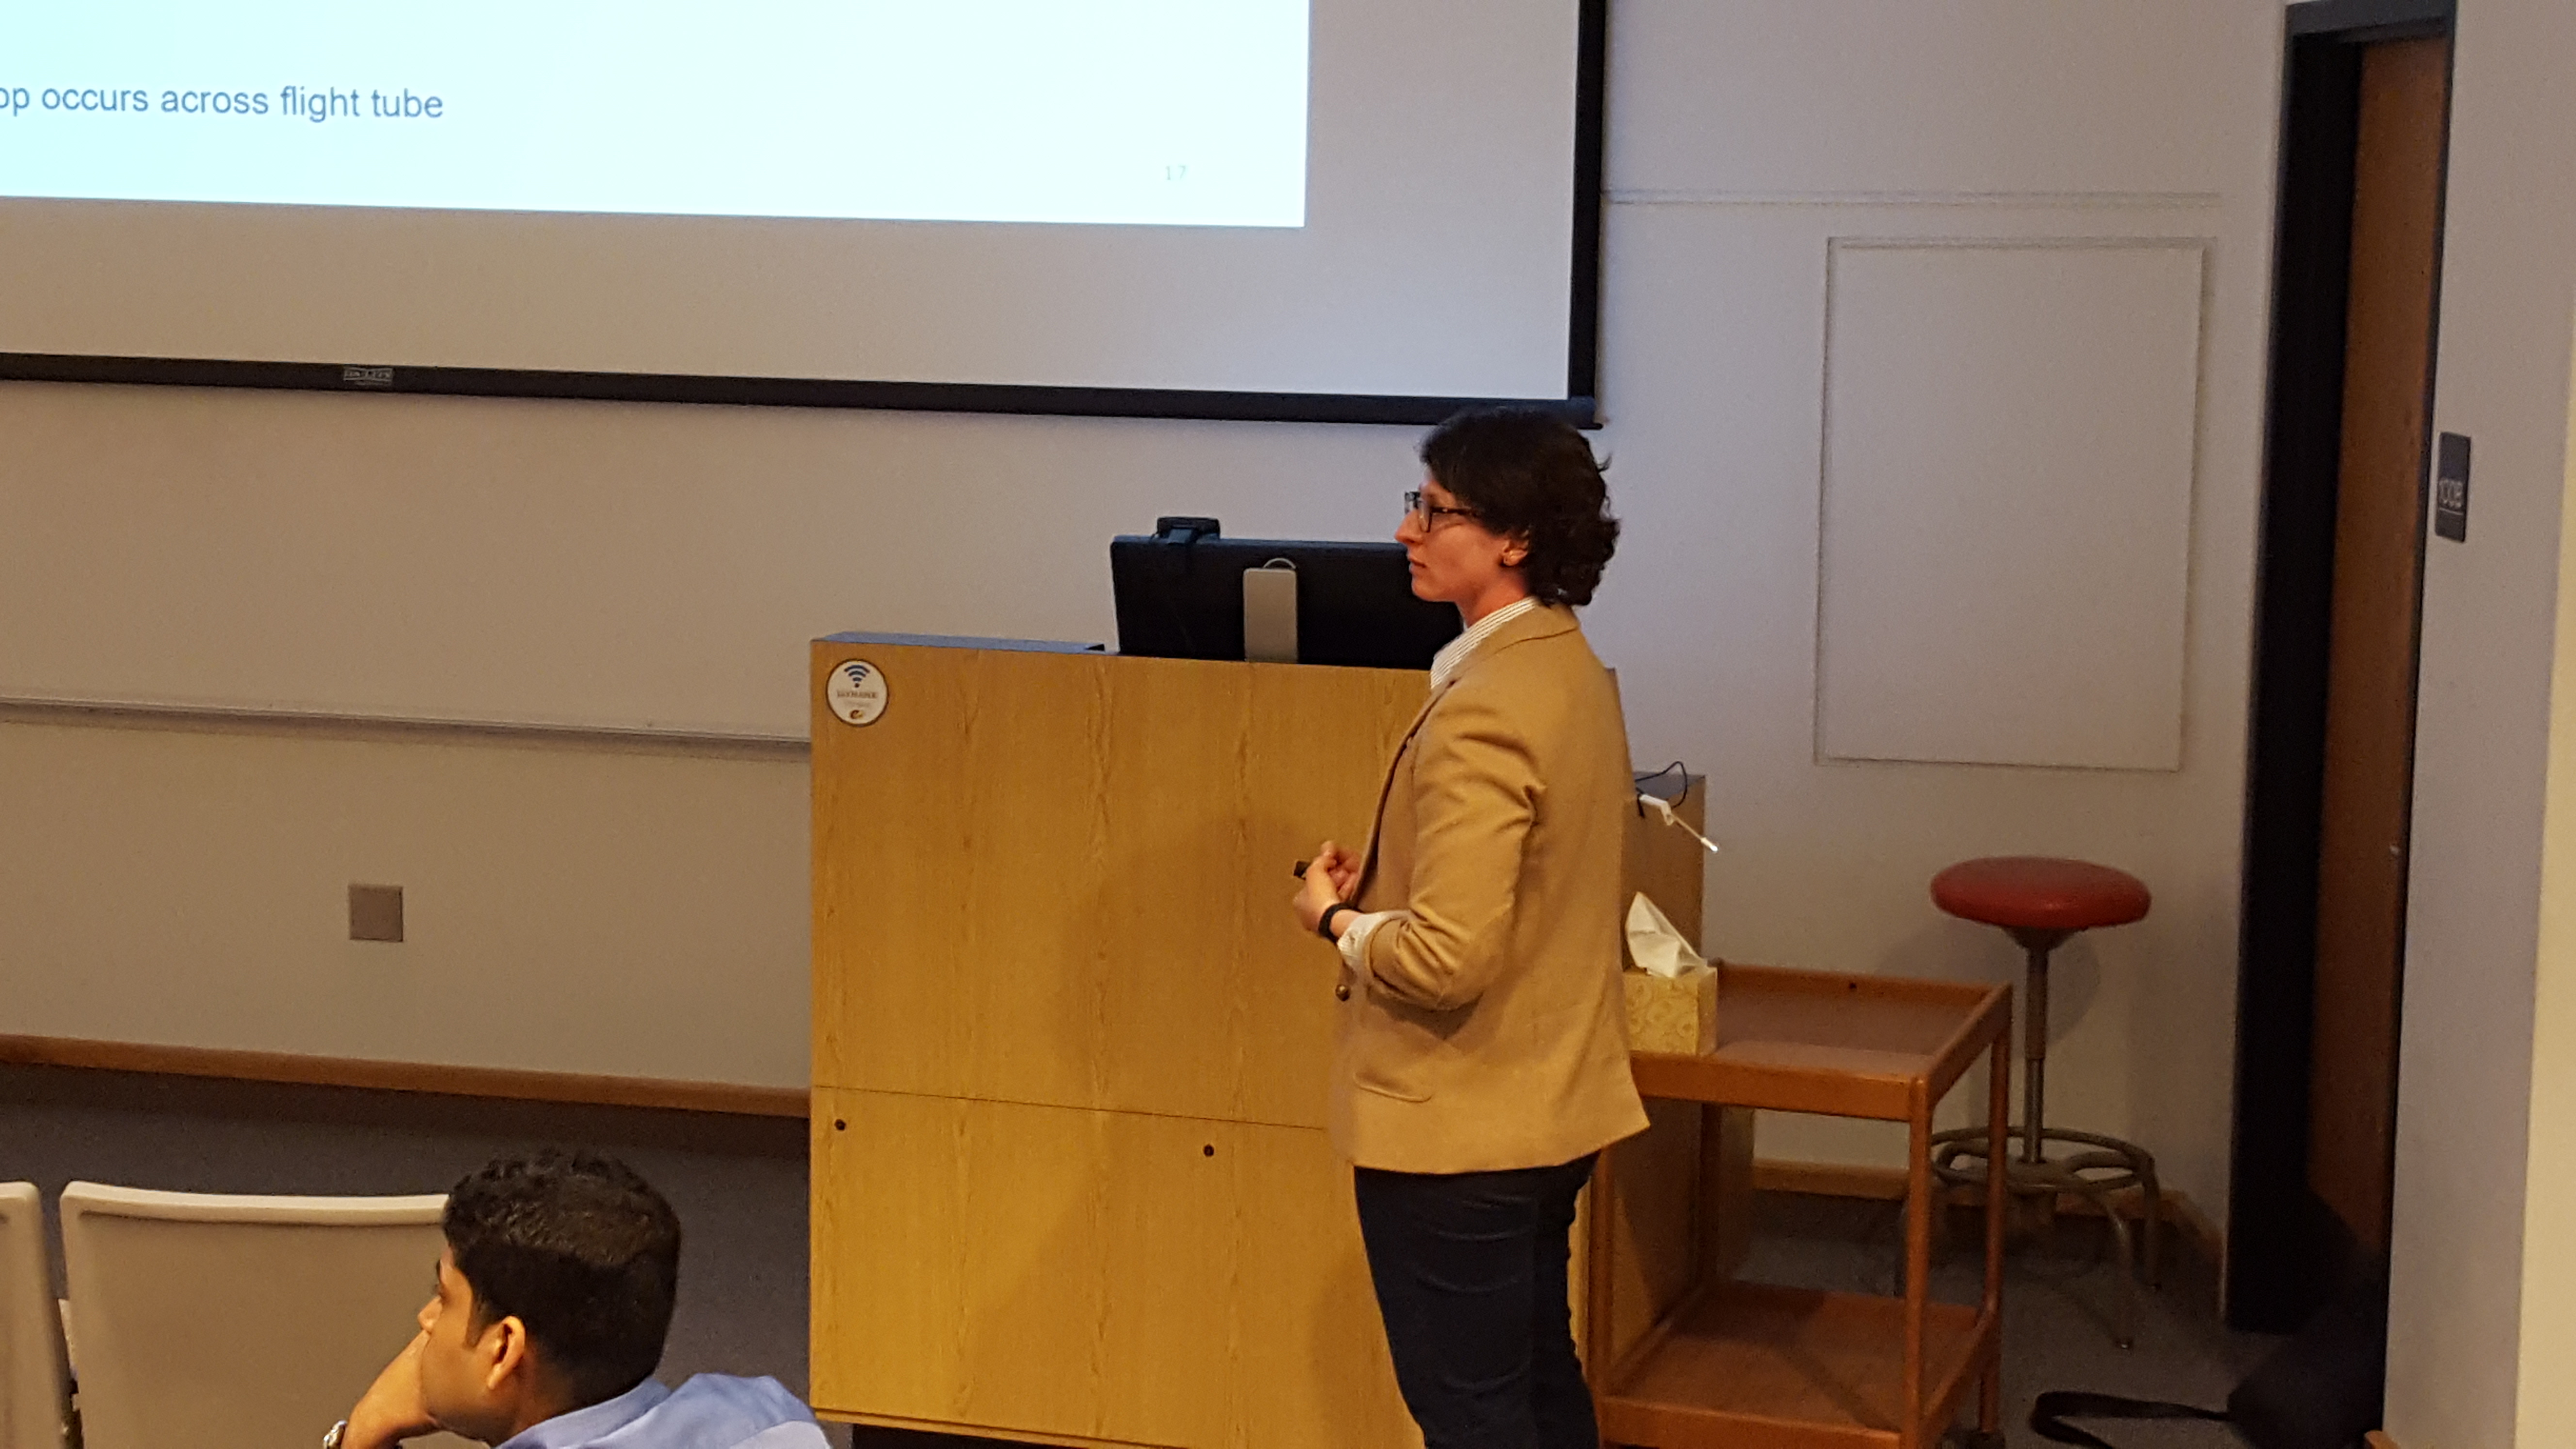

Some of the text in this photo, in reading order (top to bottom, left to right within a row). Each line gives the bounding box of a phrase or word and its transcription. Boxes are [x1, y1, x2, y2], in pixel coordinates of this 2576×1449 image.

[42, 88, 149, 112] occurs
[161, 90, 269, 114] across
[280, 85, 360, 123] flight
[370, 88, 443, 118] tube
[1165, 165, 1187, 180] 17
